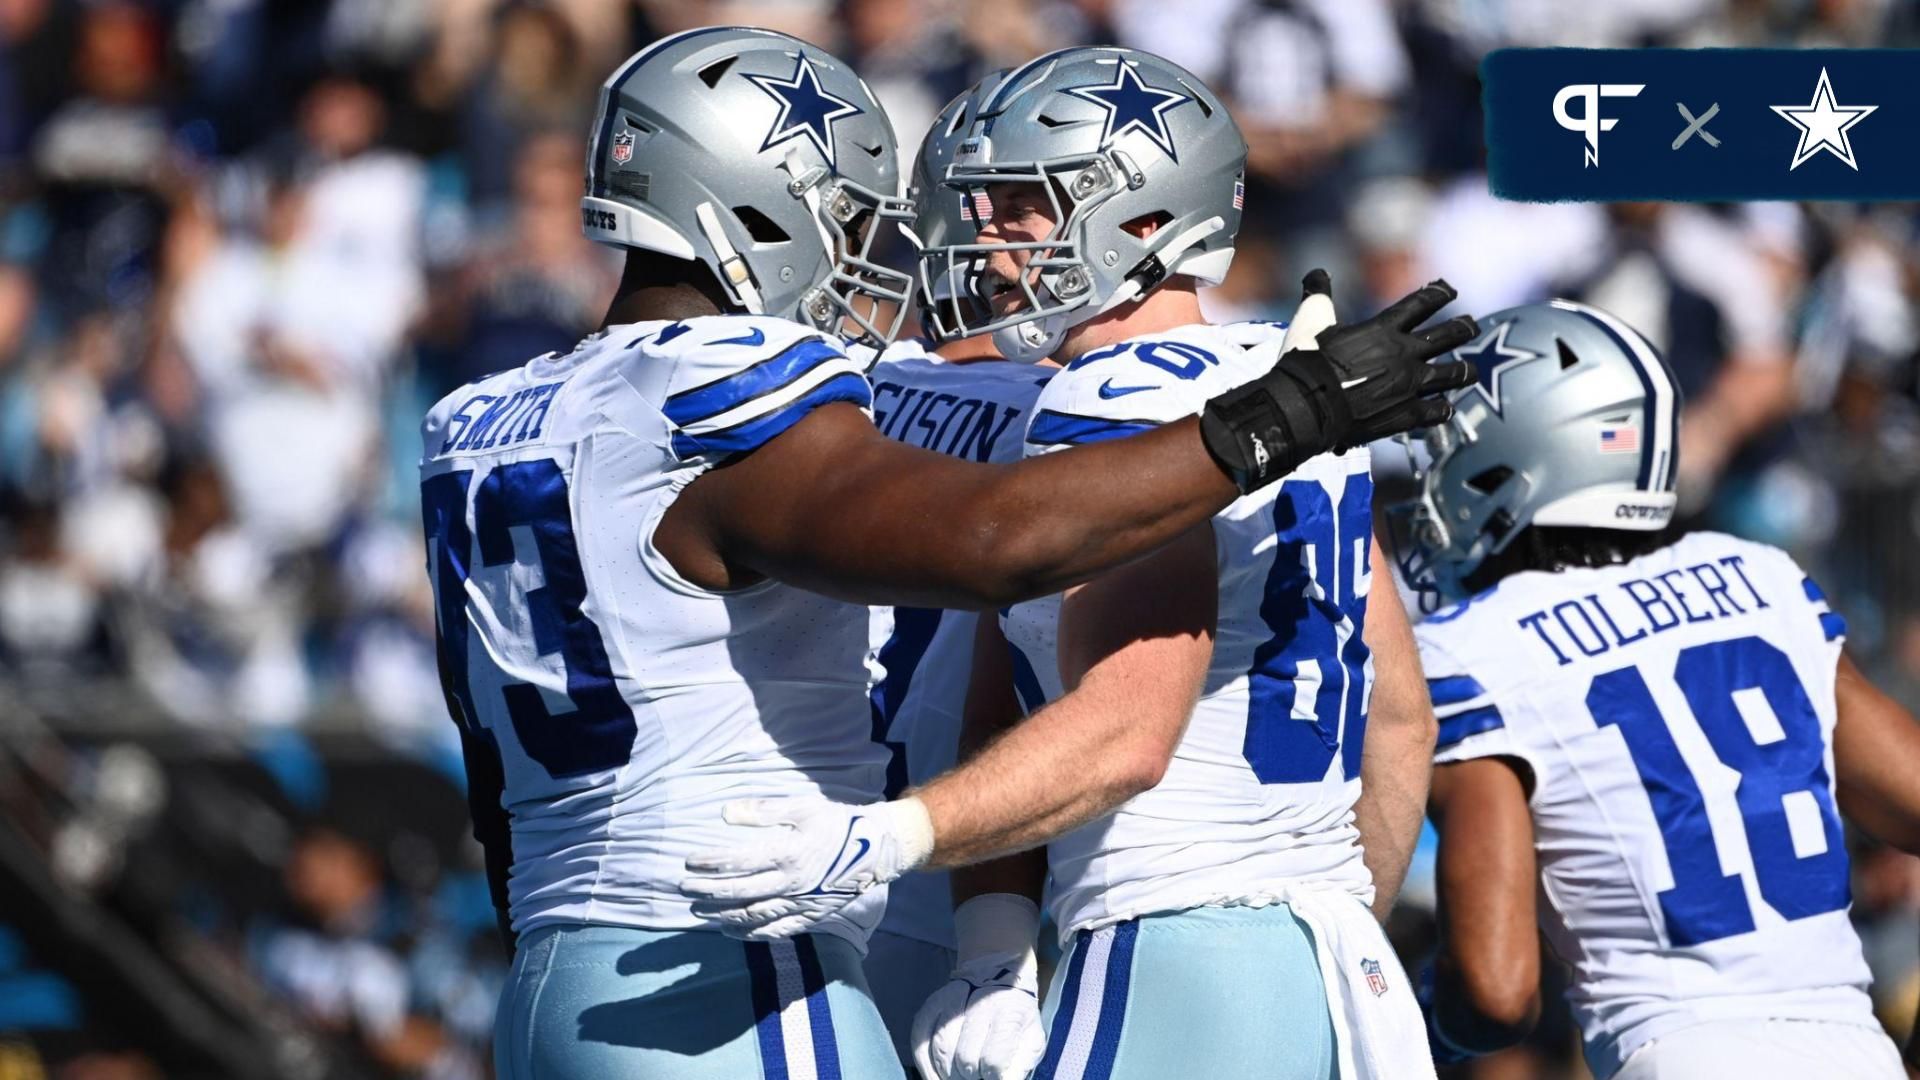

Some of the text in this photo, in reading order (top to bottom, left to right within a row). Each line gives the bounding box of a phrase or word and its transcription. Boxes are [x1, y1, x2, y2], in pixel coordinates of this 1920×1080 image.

[441, 381, 565, 456] SMITH
[866, 376, 1021, 464] GUSON
[421, 458, 638, 779] 73
[1518, 555, 1770, 666] TOLBERT
[1585, 635, 1853, 948] 18
